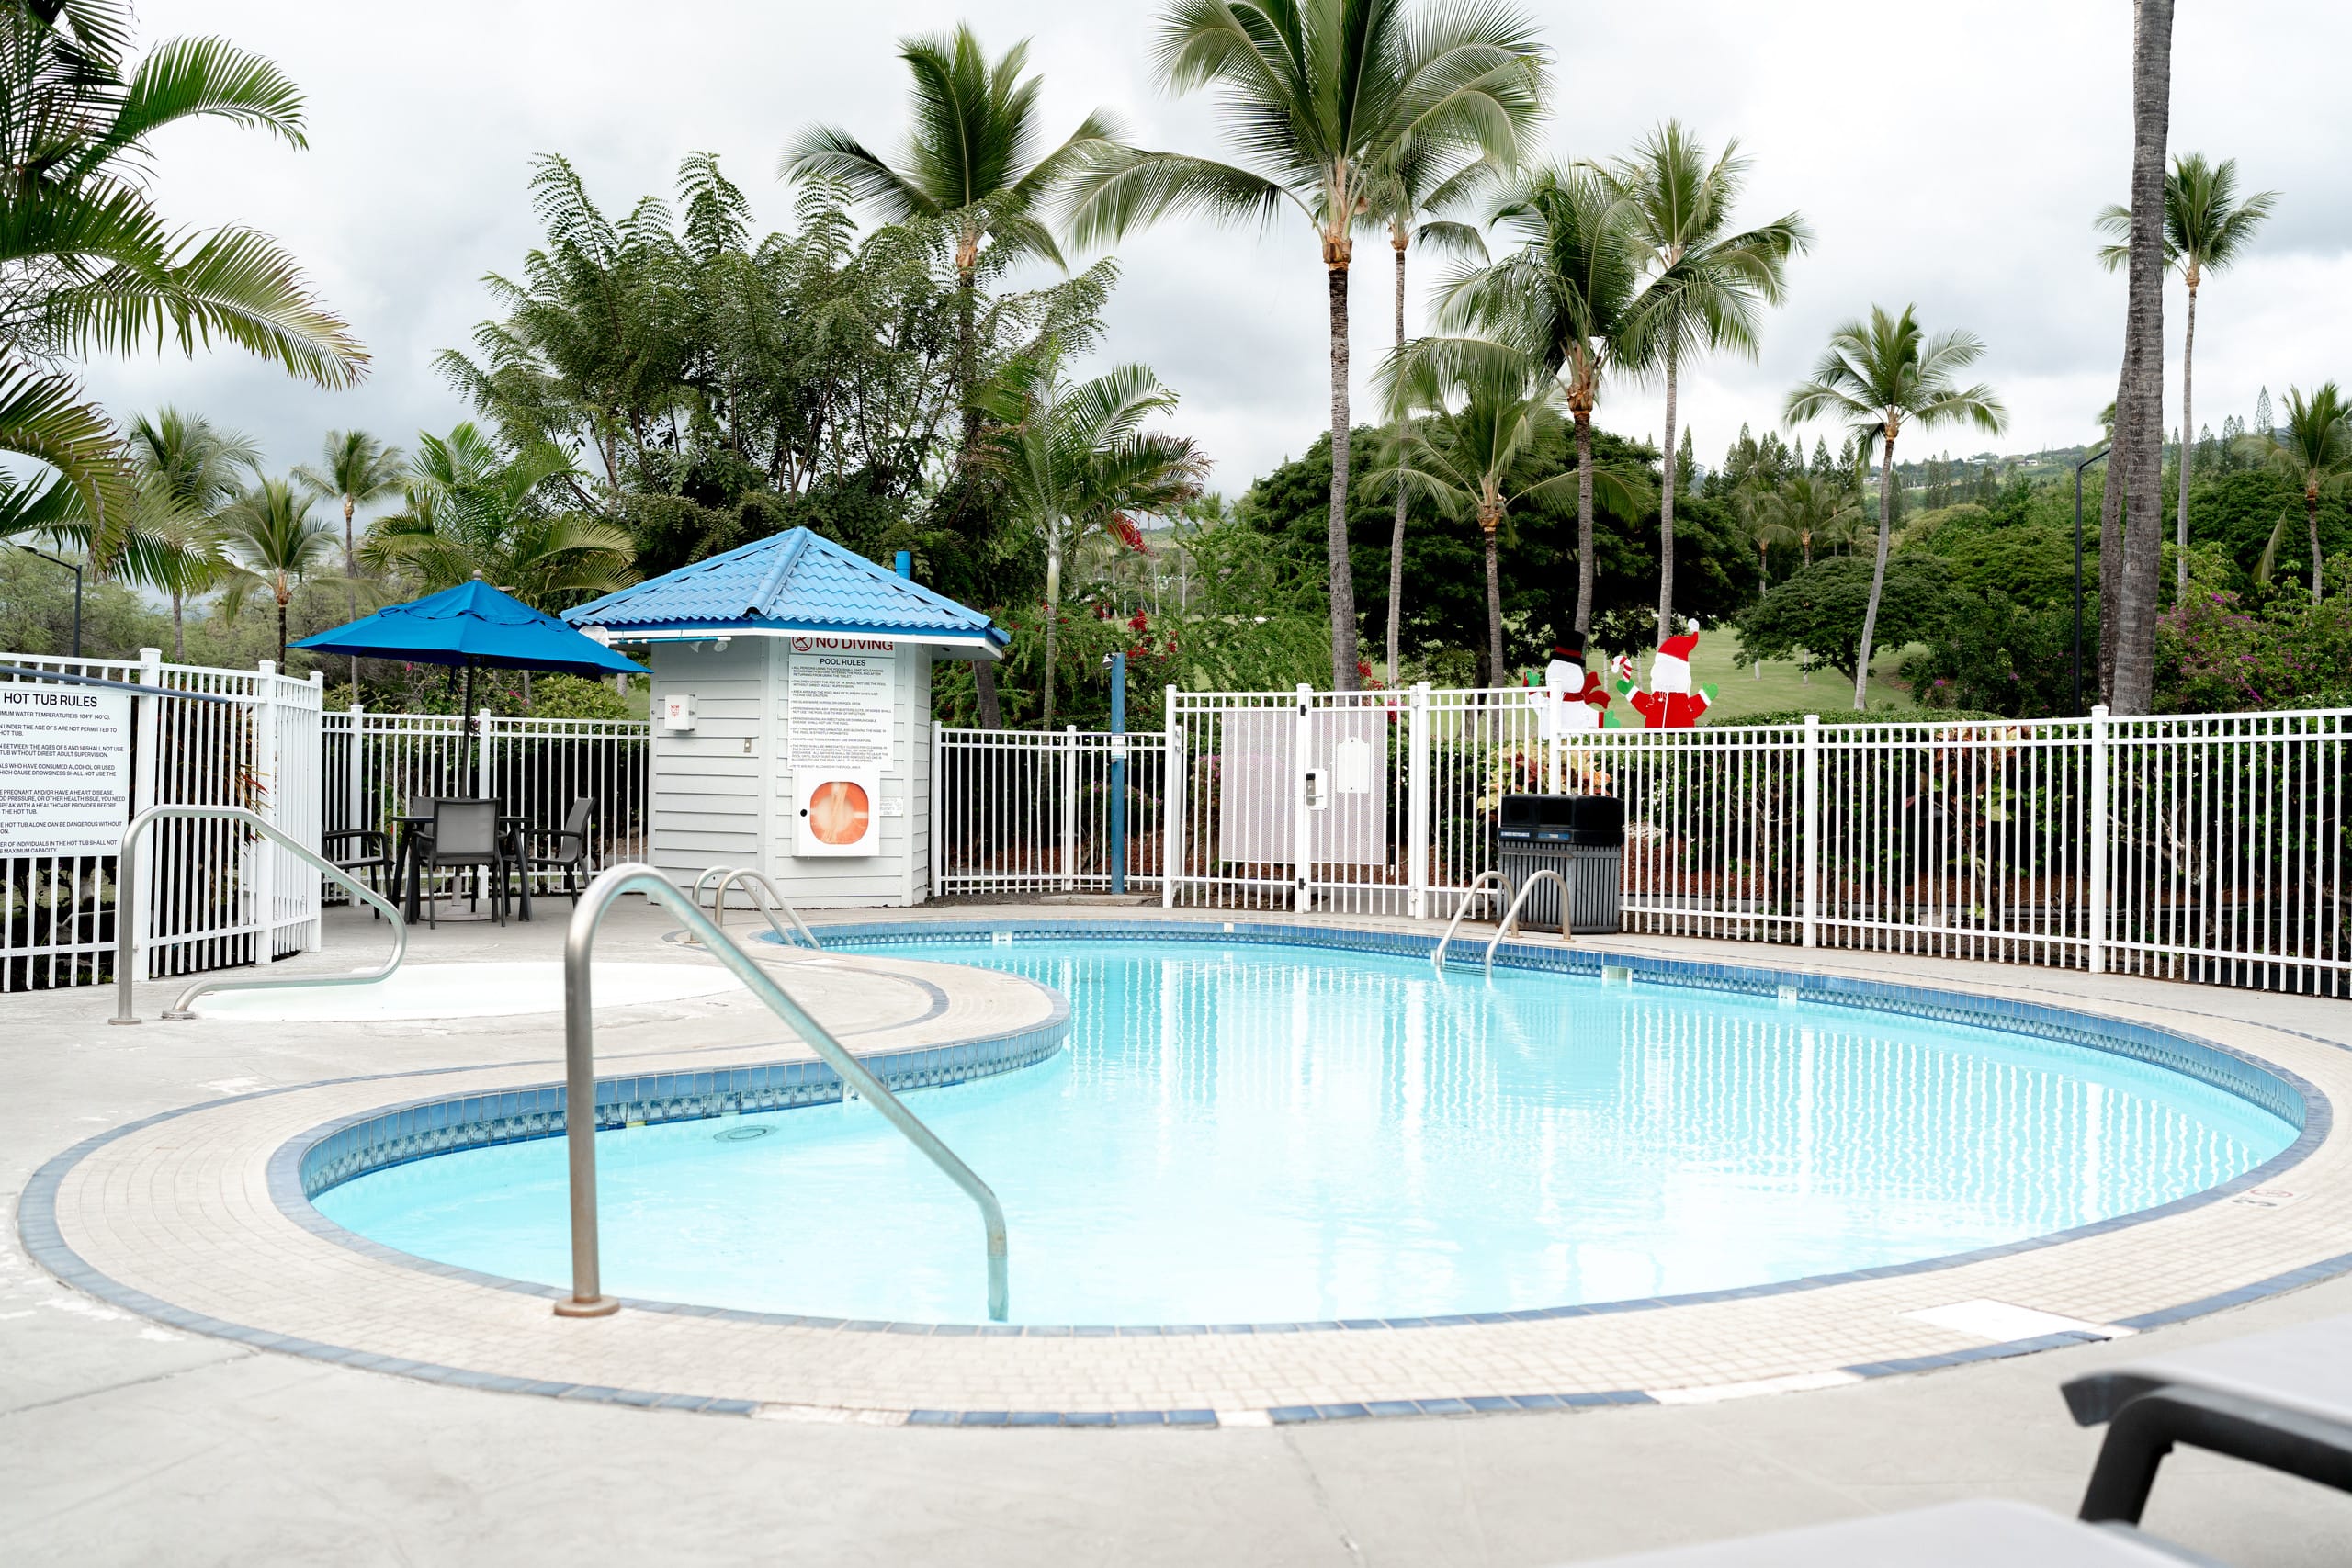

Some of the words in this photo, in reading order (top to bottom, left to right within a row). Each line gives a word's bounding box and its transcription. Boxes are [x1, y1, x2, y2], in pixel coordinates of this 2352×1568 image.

[816, 638, 838, 648] NO
[842, 639, 893, 651] DIVING
[820, 658, 841, 666] POOL
[842, 659, 866, 667] RULES
[4, 692, 30, 704] HOT
[33, 694, 57, 705] TUB
[60, 695, 97, 707] RULES
